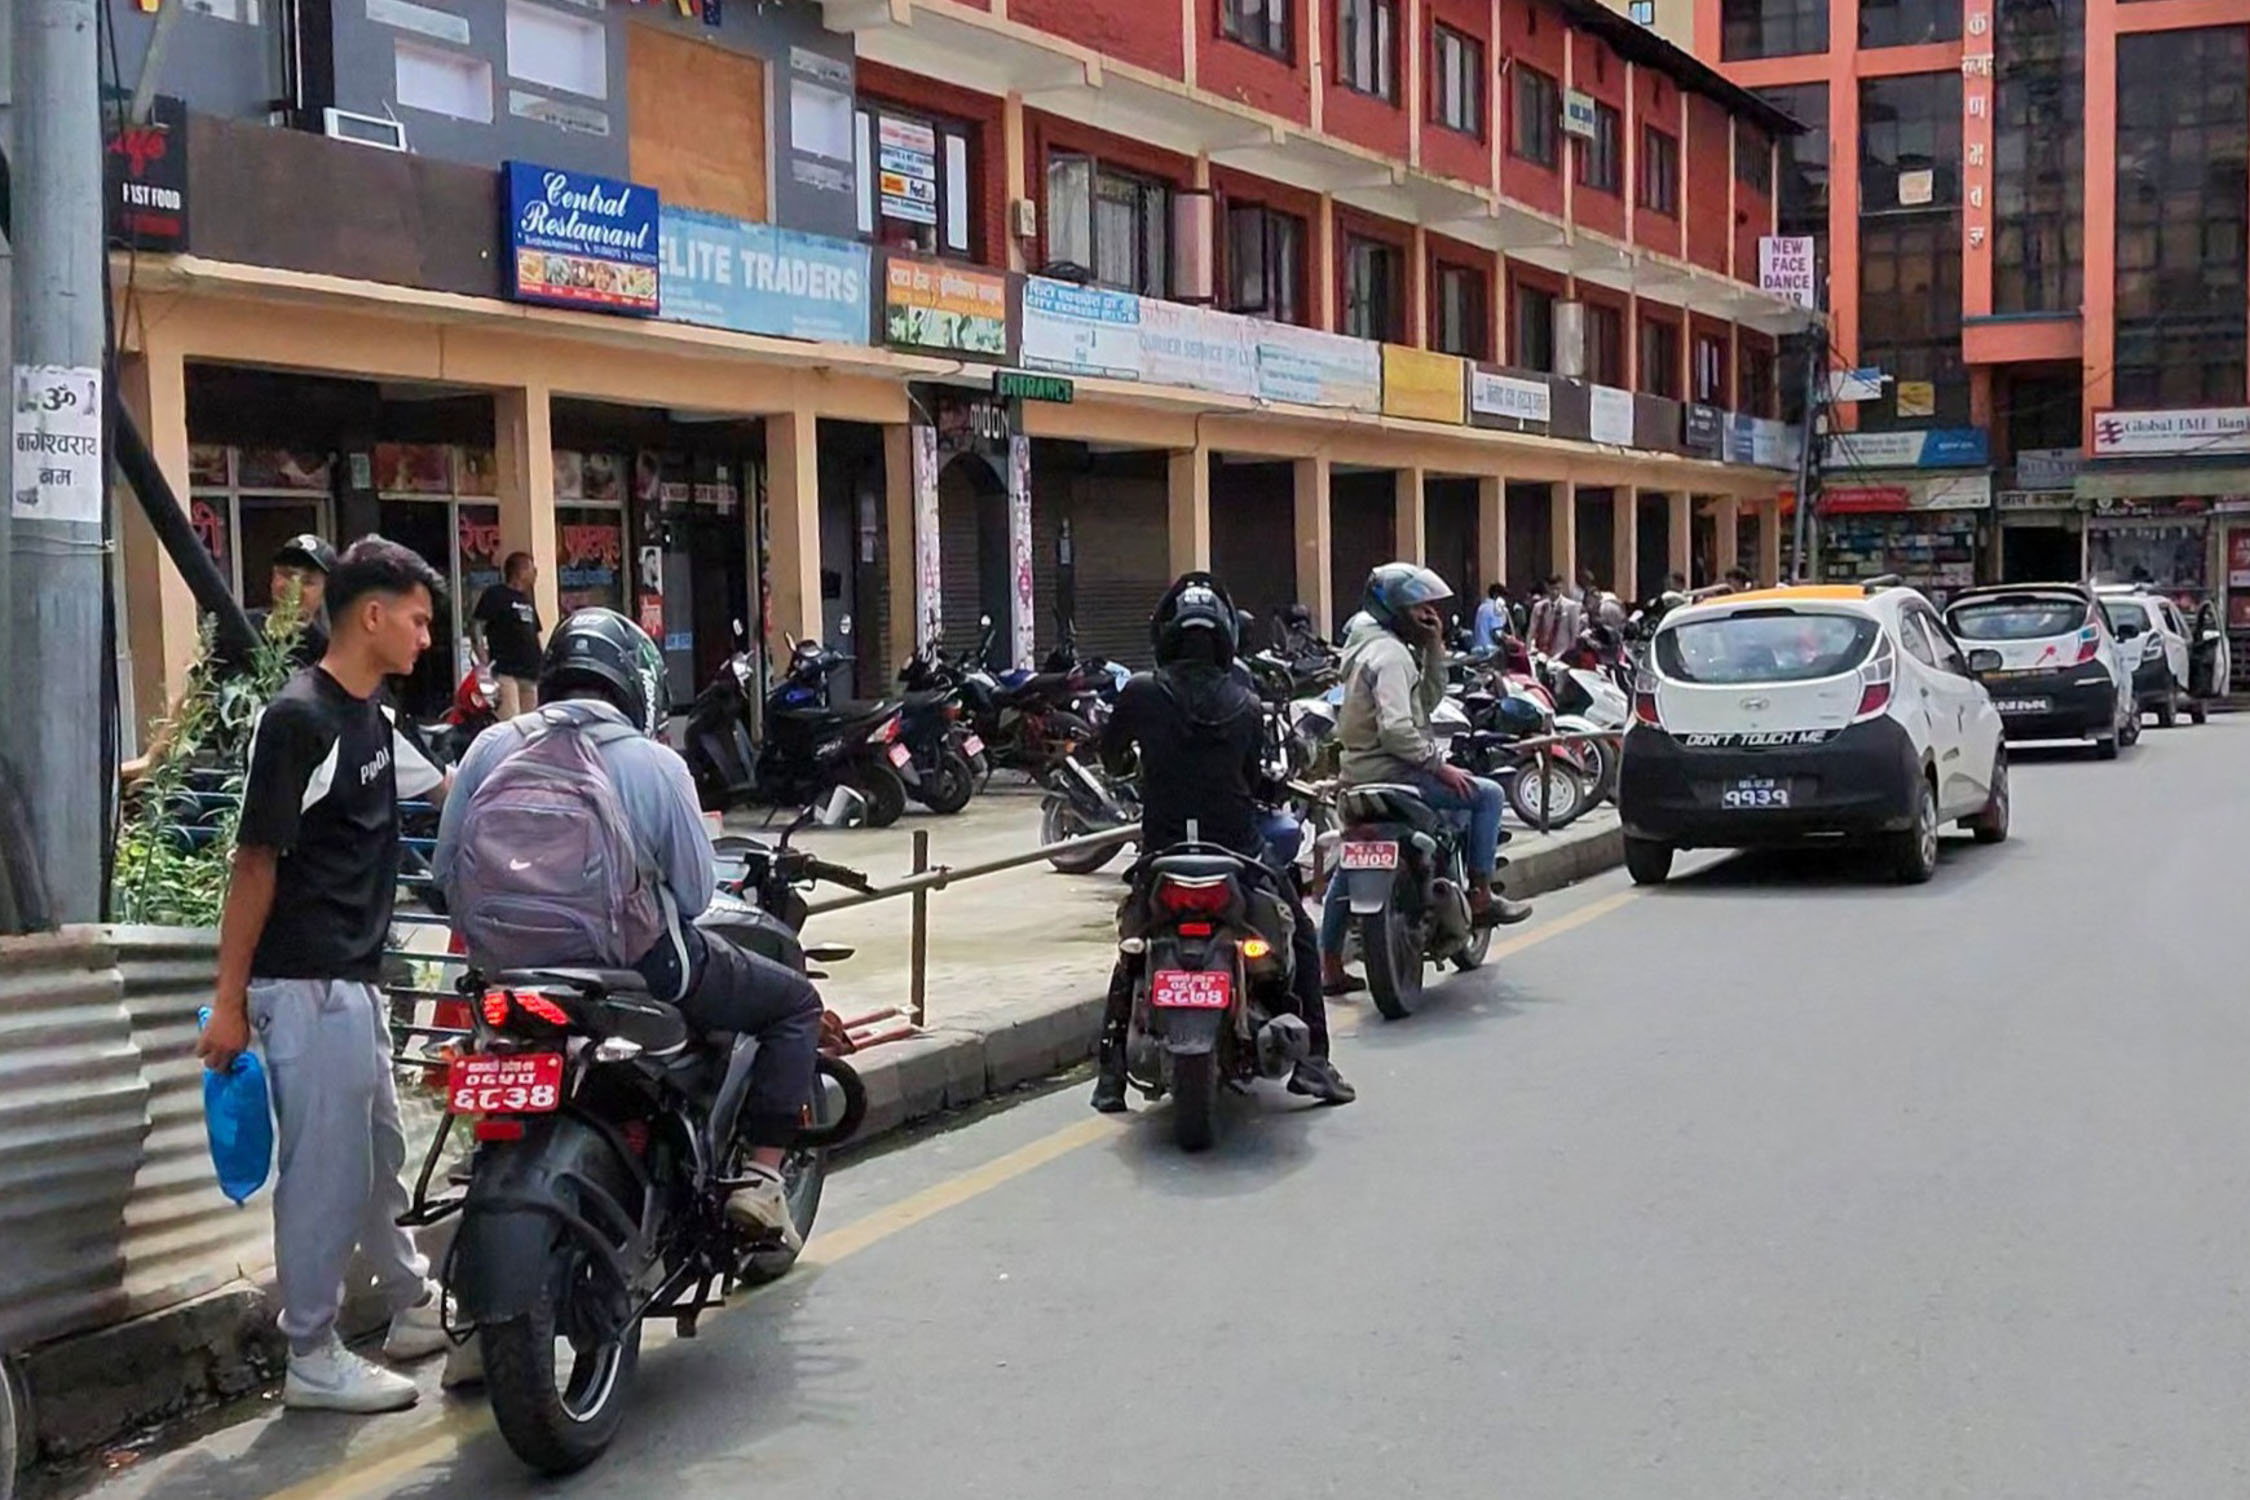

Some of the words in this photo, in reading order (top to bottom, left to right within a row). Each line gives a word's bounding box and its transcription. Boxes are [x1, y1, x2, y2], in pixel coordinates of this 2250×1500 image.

[151, 187, 181, 210] FOOD
[543, 171, 631, 217] Central
[521, 200, 649, 249] Restaurant
[1772, 239, 1804, 255] NEW
[740, 249, 859, 303] TRADERS
[1772, 257, 1807, 272] FACE
[1764, 274, 1810, 289] DANCE
[1000, 373, 1073, 402] ENTRANCE
[2124, 419, 2172, 433] Global
[1686, 733, 1734, 746] DON'T
[1740, 732, 1794, 746] TOUCH
[1798, 730, 1827, 744] ME
[454, 1084, 555, 1111] ६८३४
